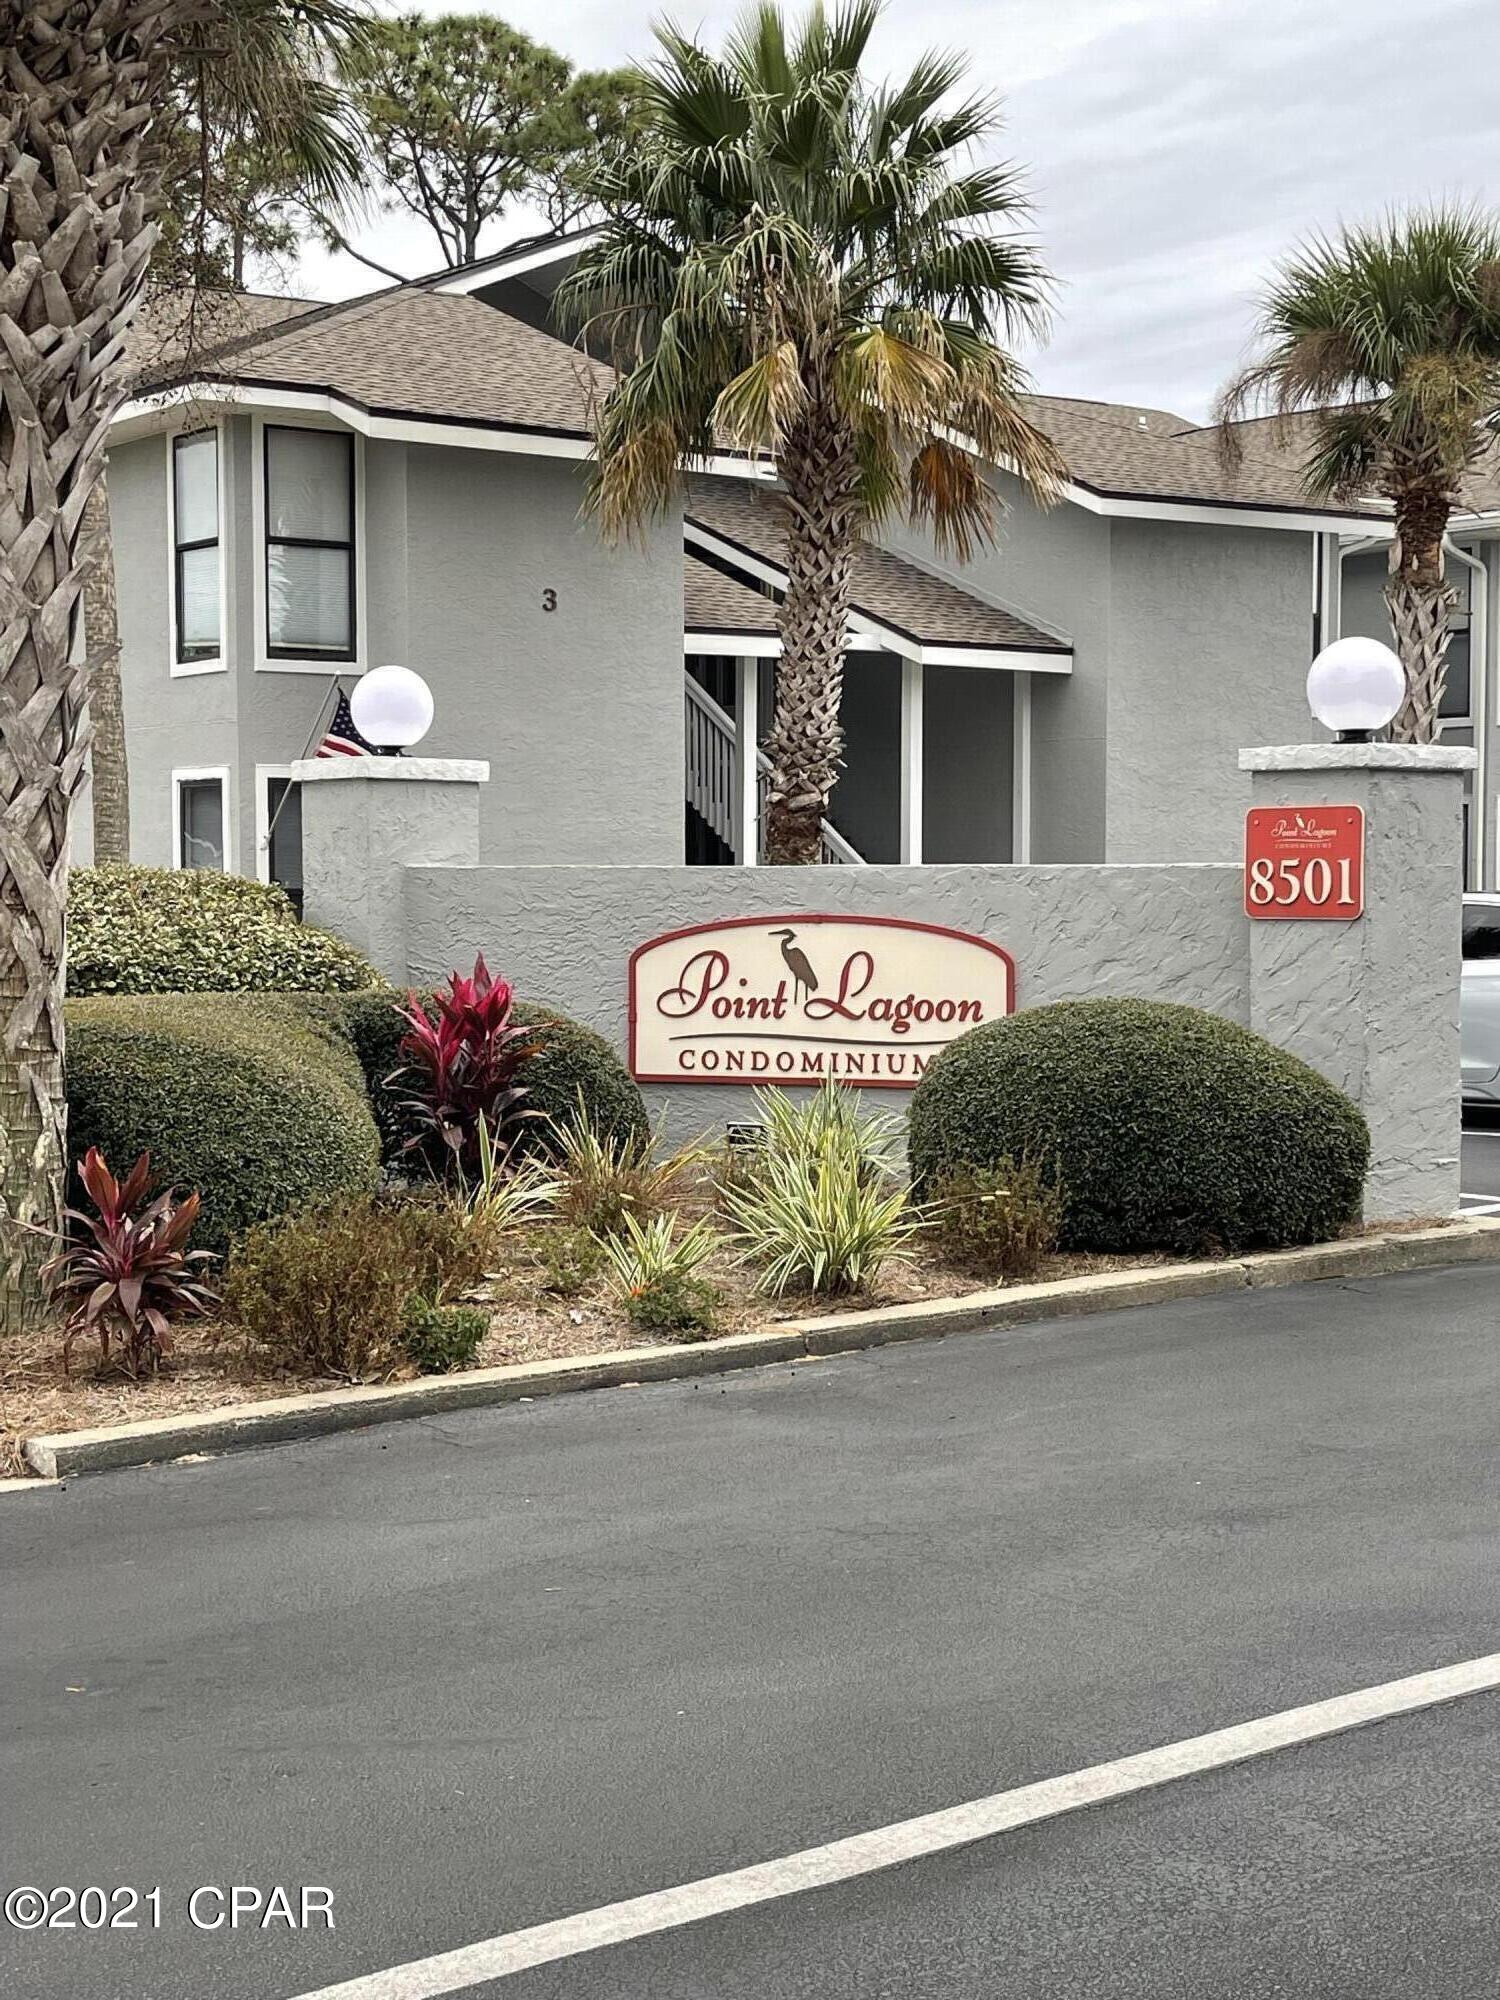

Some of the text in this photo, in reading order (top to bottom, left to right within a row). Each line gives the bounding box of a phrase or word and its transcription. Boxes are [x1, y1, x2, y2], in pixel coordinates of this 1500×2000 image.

[542, 588, 558, 612] 3
[1250, 858, 1355, 905] 8501
[656, 949, 984, 1034] Point Lagoon
